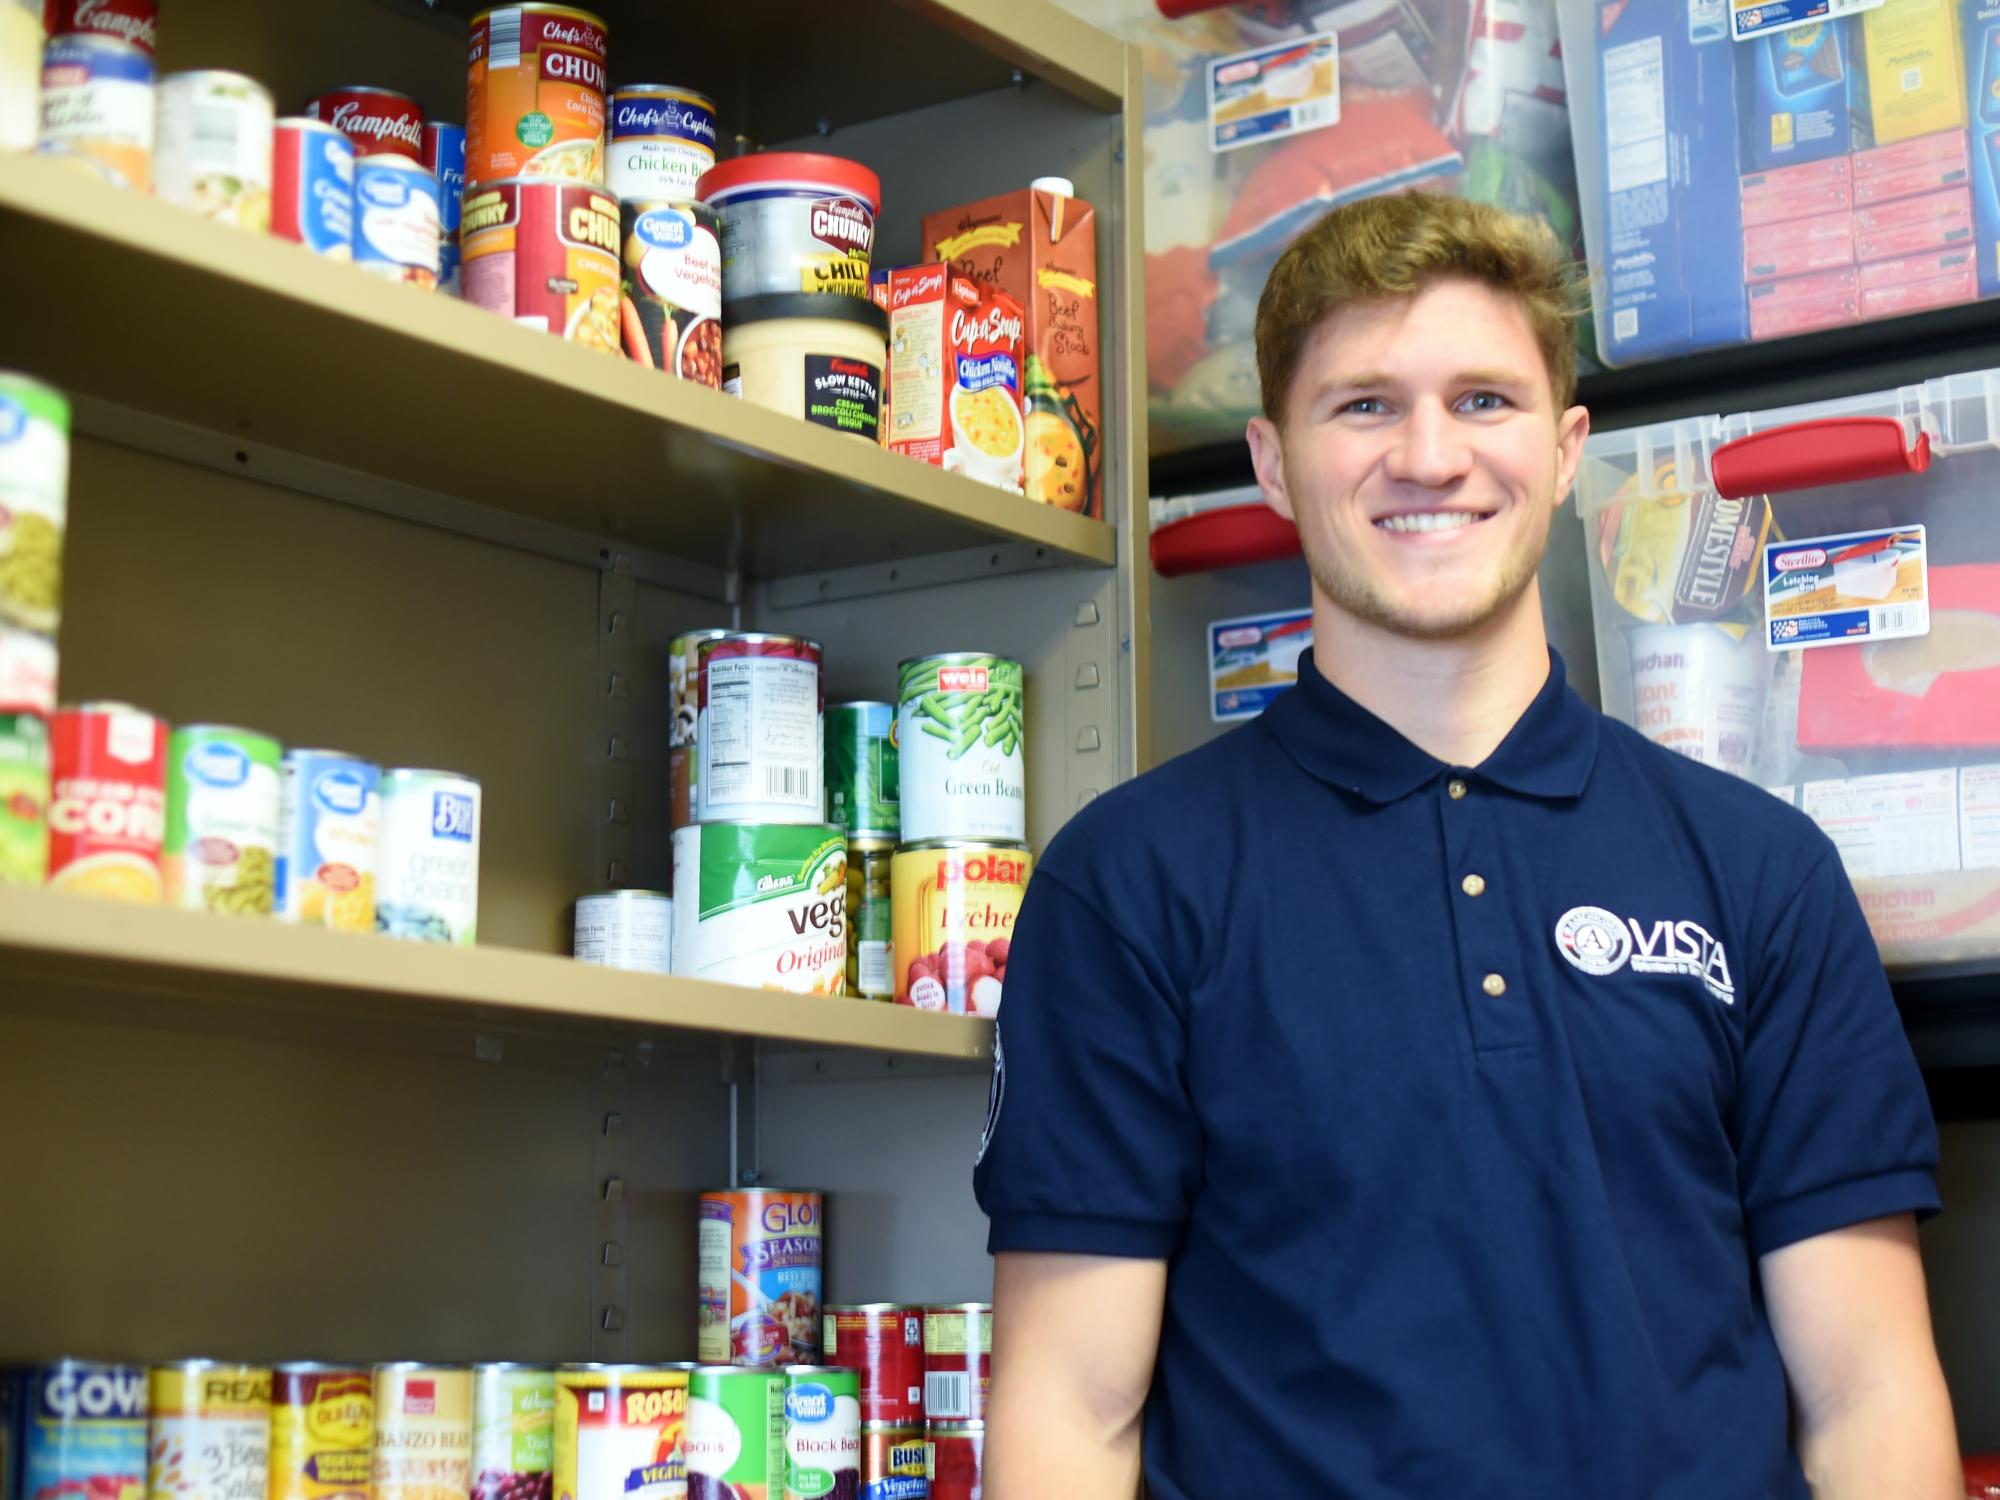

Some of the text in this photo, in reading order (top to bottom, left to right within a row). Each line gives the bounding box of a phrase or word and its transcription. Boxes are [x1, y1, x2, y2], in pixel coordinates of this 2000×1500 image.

[627, 154, 688, 175] Chicken
[642, 217, 684, 237] Great
[812, 210, 871, 250] CHUNKY
[814, 260, 866, 281] CHILI
[960, 360, 991, 378] Chicken
[814, 373, 846, 391] SLOW
[1689, 496, 1744, 605] OMESTYLE
[945, 776, 992, 797] Green
[936, 854, 1026, 892] polar
[1628, 917, 1732, 987] VISTA
[786, 1390, 827, 1408] Great
[796, 1404, 828, 1419] Value
[796, 1437, 837, 1453] Black
